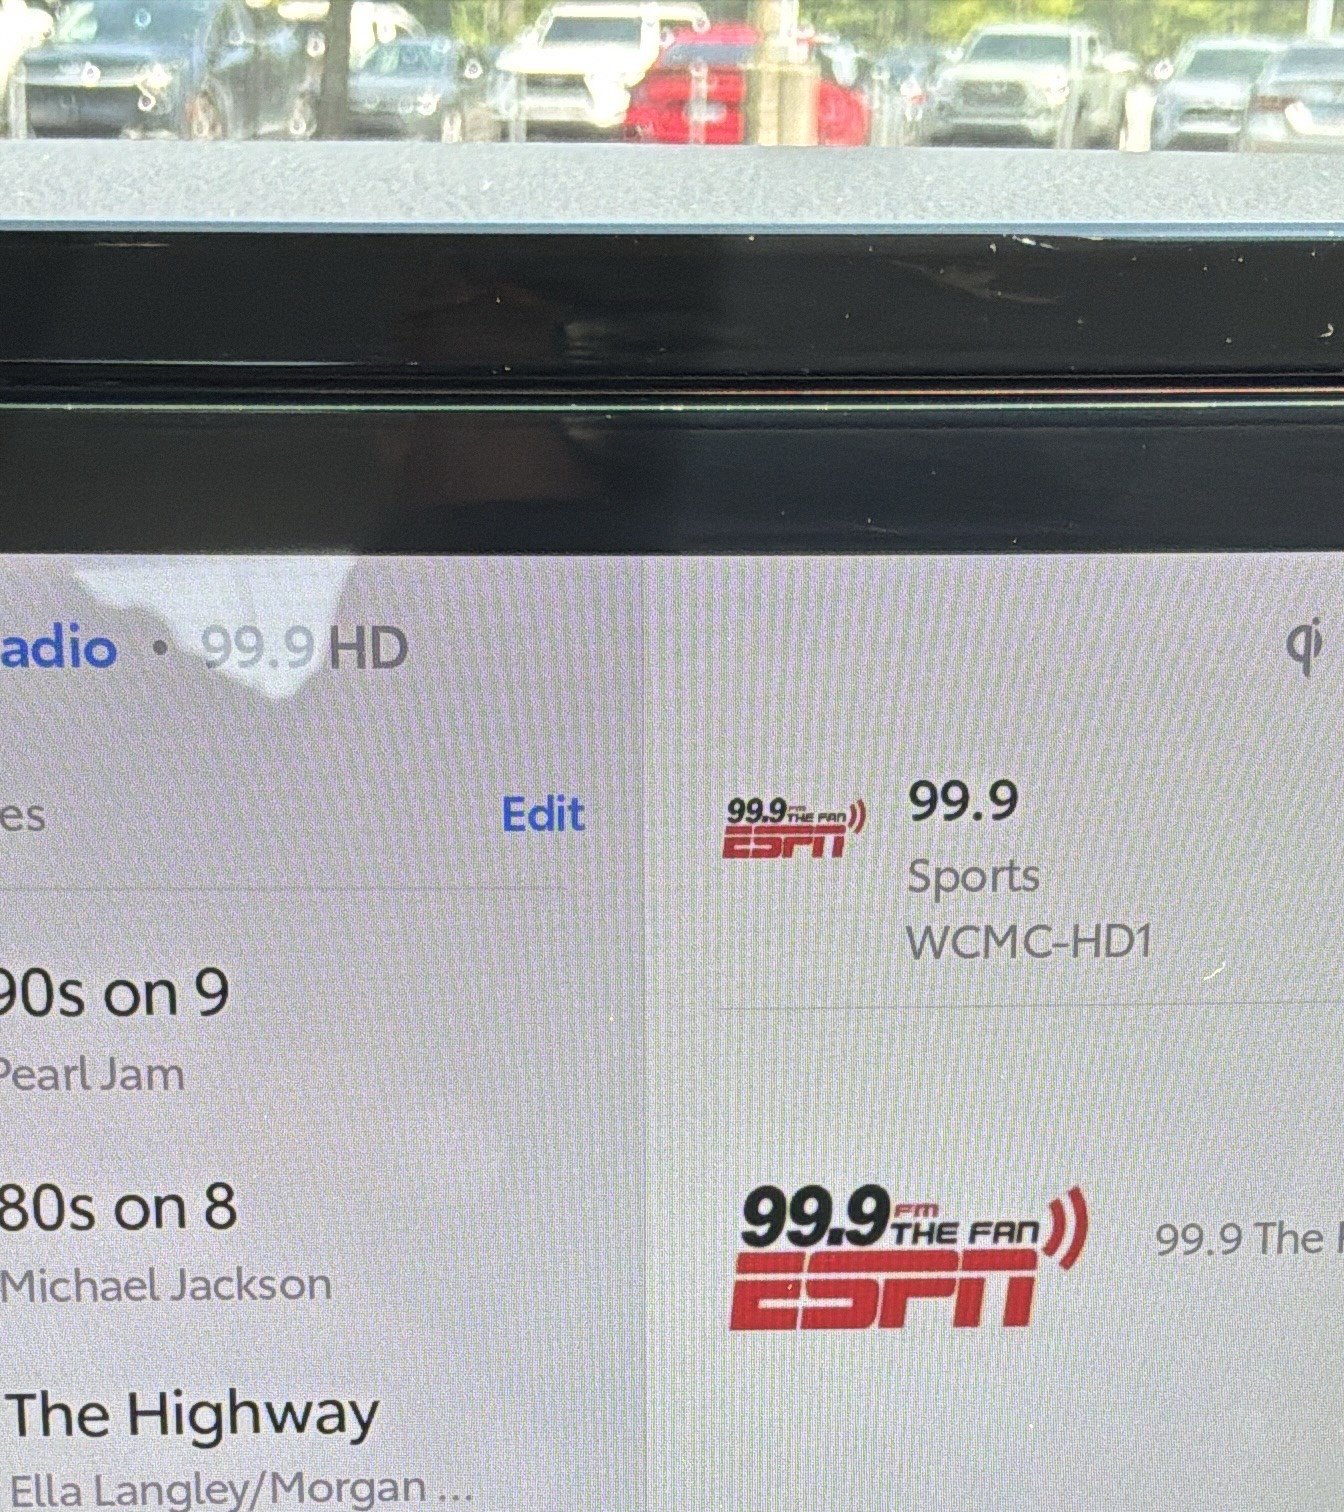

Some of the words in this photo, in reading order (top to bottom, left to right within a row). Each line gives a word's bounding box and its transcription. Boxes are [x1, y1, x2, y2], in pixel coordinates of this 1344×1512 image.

[202, 625, 316, 670] 99.9
[330, 625, 409, 670] HD
[502, 795, 585, 833] Edit
[727, 797, 787, 824] 99.9
[787, 812, 815, 823] THE
[817, 812, 847, 823] FAN
[908, 778, 1019, 822] 99.9
[722, 824, 847, 859] ESPN
[908, 857, 1040, 903] Sports
[905, 922, 1151, 961] WCMC-HD1
[104, 979, 178, 1018] on
[195, 966, 230, 1018] 9
[100, 1055, 186, 1092] Jam
[113, 1193, 187, 1232] on
[204, 1181, 238, 1231] 8
[741, 1183, 892, 1248] 99.9
[894, 1203, 940, 1218] FM
[891, 1221, 960, 1245] THE
[969, 1220, 1040, 1245] FAN
[1155, 1221, 1244, 1257] 99.9
[1254, 1219, 1325, 1255] The
[0, 1266, 160, 1304] Michael
[170, 1265, 333, 1303] Jackson
[730, 1248, 1038, 1331] ESPN
[4, 1389, 110, 1439] The
[128, 1387, 380, 1450] Highway
[10, 1474, 83, 1509] Ella
